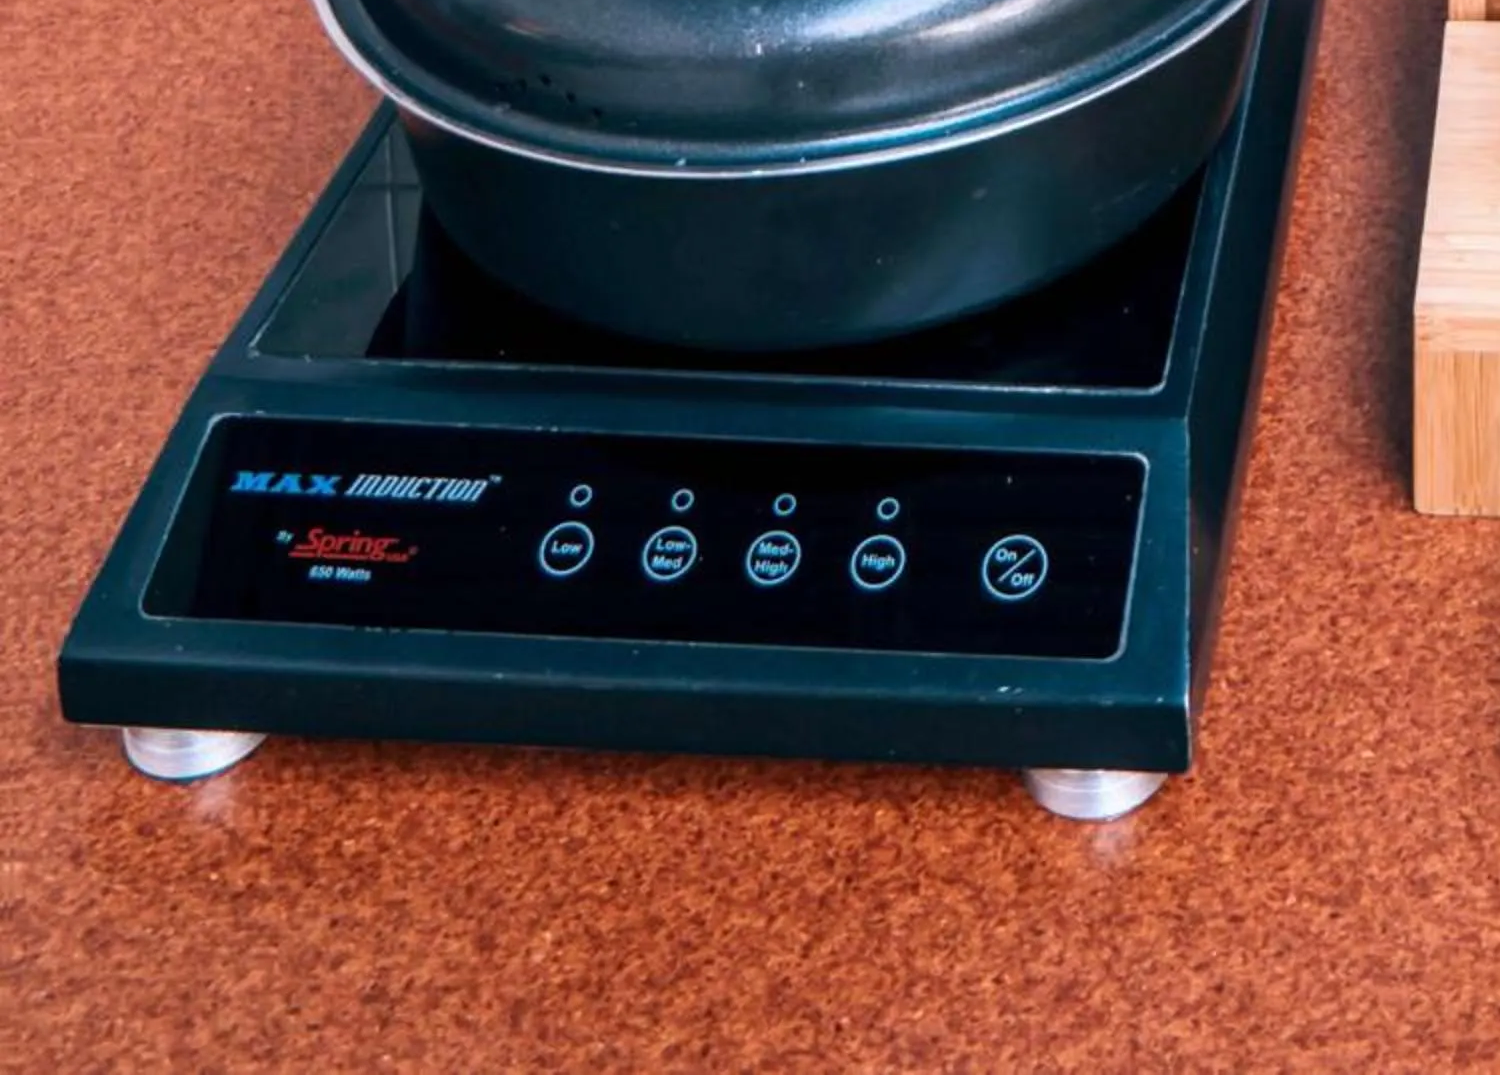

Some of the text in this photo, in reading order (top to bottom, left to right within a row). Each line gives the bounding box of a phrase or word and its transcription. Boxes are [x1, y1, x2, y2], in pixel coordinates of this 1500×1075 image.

[231, 471, 341, 495] MAX
[307, 528, 399, 561] Spring
[551, 541, 583, 554] Low
[656, 538, 691, 551] Low-
[759, 542, 794, 555] Med-
[995, 548, 1017, 561] On
[652, 556, 682, 569] Med
[755, 560, 788, 575] High
[861, 554, 896, 570] High
[335, 567, 371, 581] Watts
[1011, 573, 1034, 586] Off
